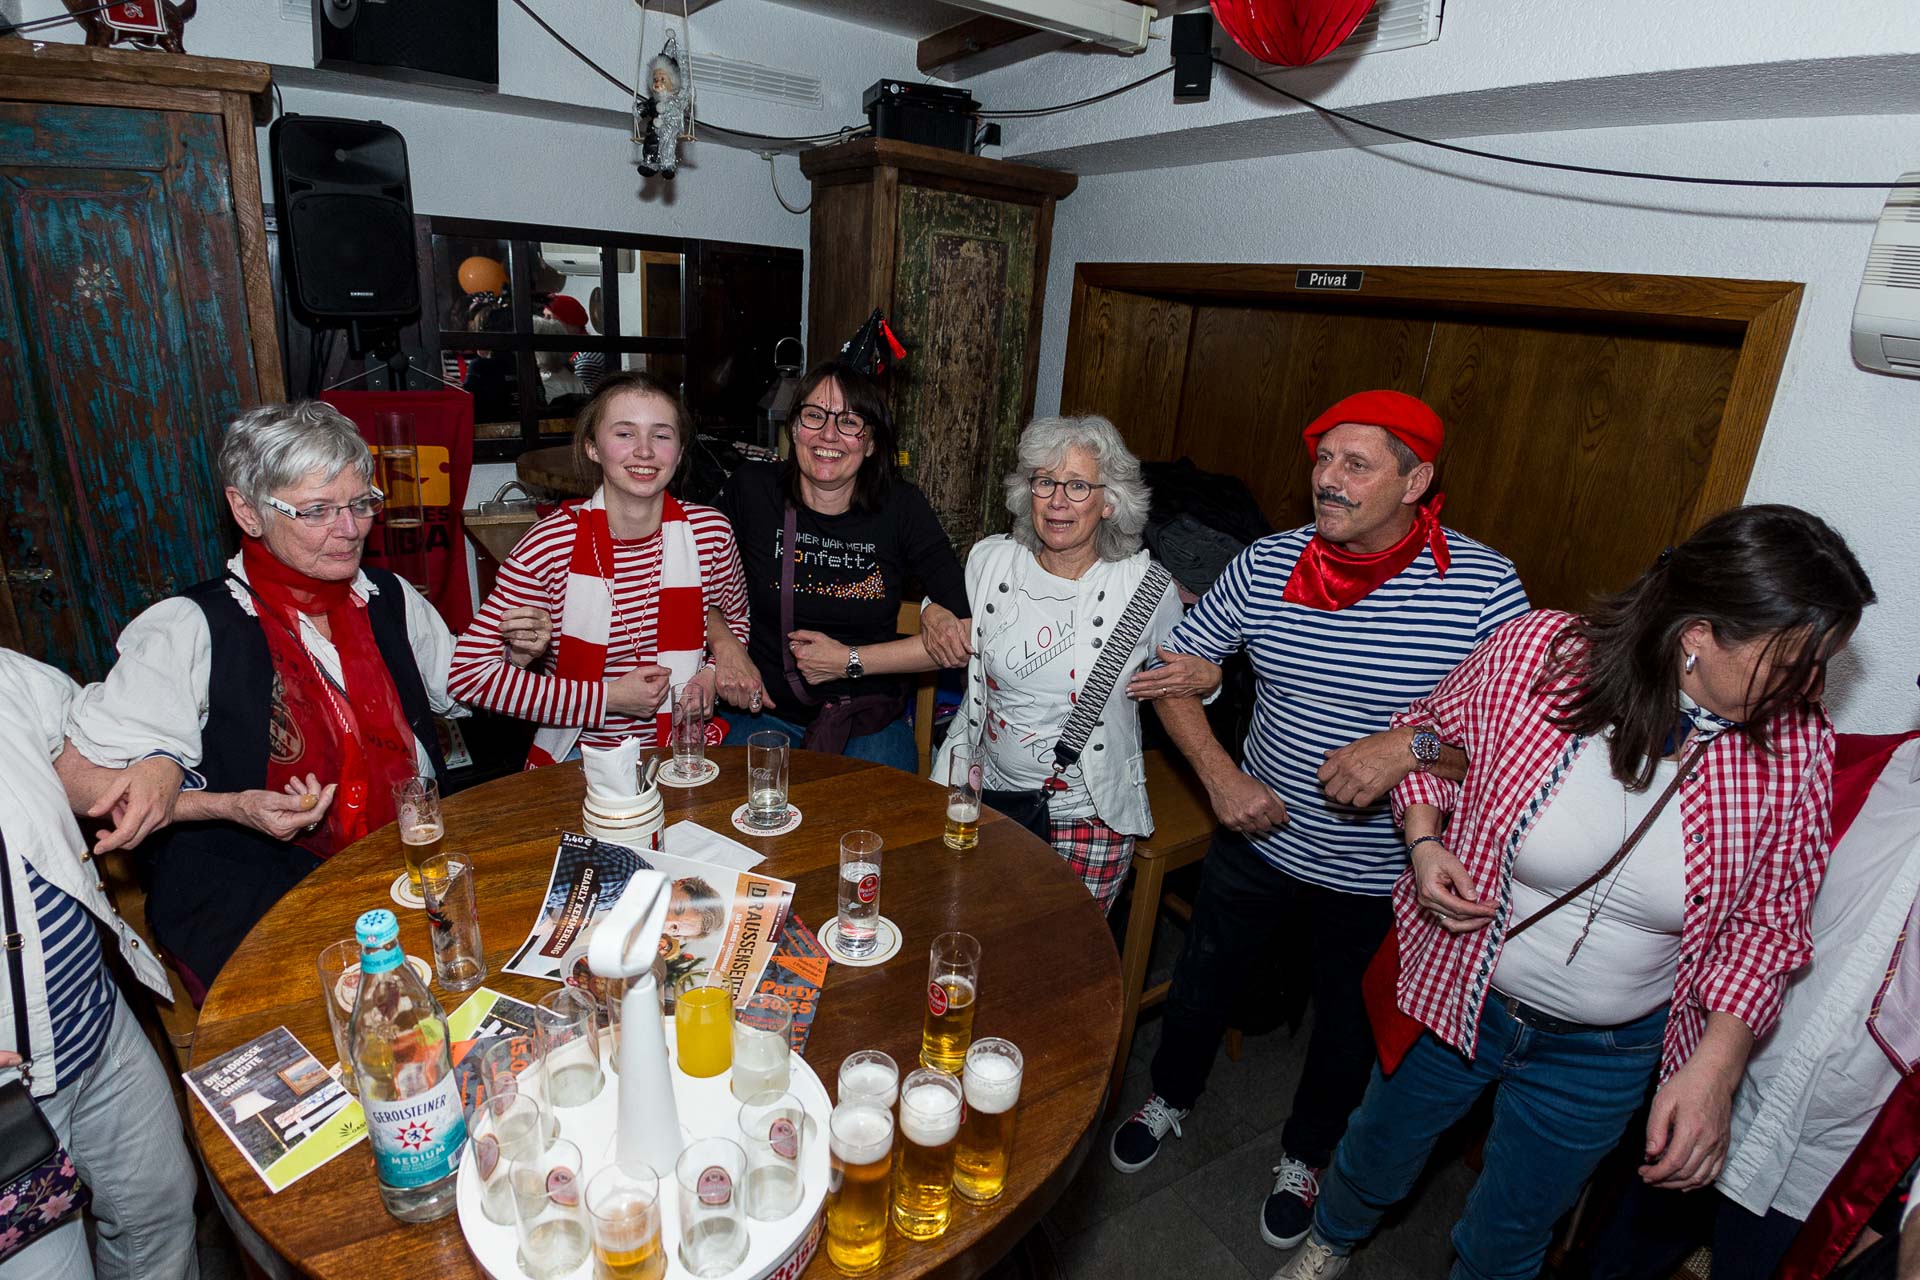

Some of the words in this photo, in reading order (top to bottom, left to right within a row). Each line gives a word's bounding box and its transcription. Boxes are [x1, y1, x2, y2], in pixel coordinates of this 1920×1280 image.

[1309, 272, 1347, 287] Privat
[776, 528, 820, 546] FHER
[822, 537, 845, 549] WAR
[845, 542, 876, 553] MEHR
[563, 834, 584, 844] 3,40
[577, 867, 594, 903] CHARLY
[550, 900, 585, 955] KEMMERLING
[761, 980, 817, 1001] Party
[203, 1072, 223, 1087] DIE
[222, 1045, 263, 1076] ADRESSE
[212, 1076, 234, 1092] FÜR
[232, 1056, 264, 1077] LEUTE
[221, 1076, 251, 1097] OHNE
[373, 1094, 447, 1123] GEROLSTEINER
[391, 1145, 446, 1165] MEDIUM
